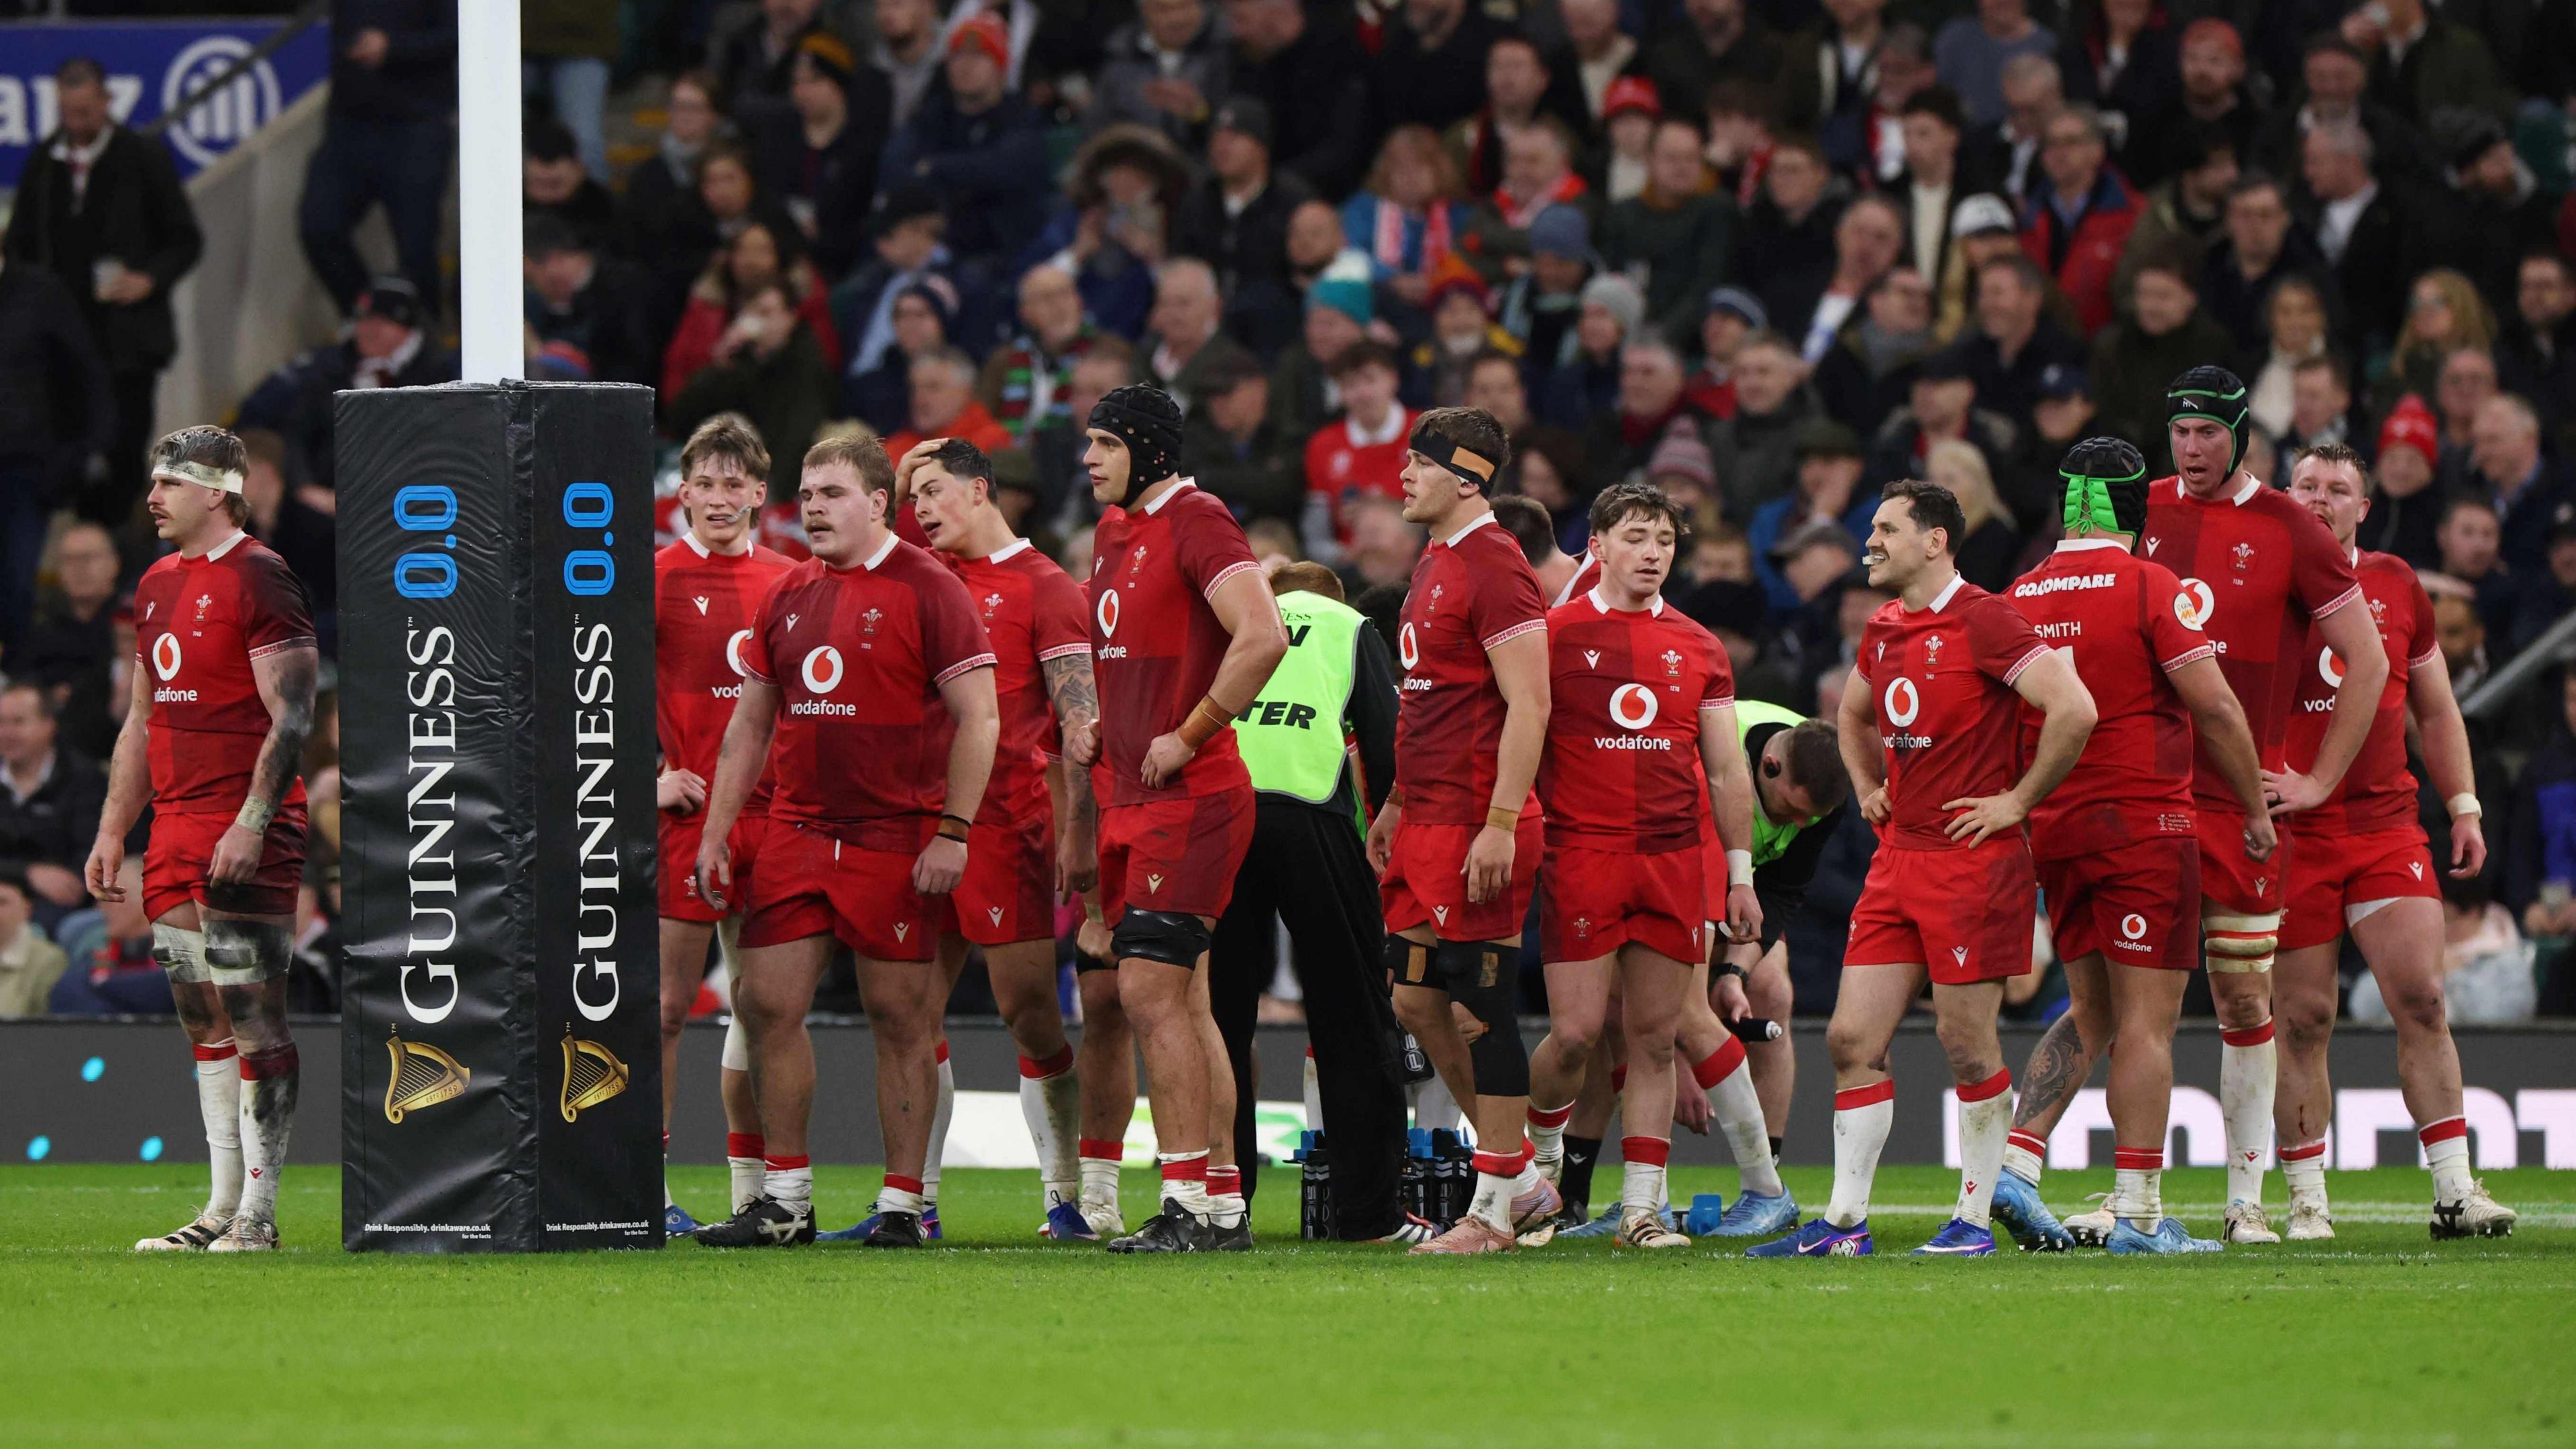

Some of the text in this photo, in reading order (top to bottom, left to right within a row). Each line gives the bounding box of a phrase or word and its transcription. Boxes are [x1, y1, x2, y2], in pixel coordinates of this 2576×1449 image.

[393, 485, 458, 599] 0.0
[563, 482, 615, 596] 0.0
[2015, 573, 2116, 598] GO.COMPARE
[2034, 621, 2081, 639] SMITH
[791, 699, 857, 716] vodafone
[1237, 700, 1317, 730] TER
[1594, 734, 1671, 751] vodafone
[400, 626, 459, 1024] GUINNESS
[572, 623, 620, 1022] GUINNESS
[2113, 938, 2152, 953] vodafone
[364, 1224, 382, 1232] Drink
[430, 1224, 491, 1232] drinkaware.co.uk
[546, 1223, 561, 1232] Drink
[599, 1220, 649, 1230] drinkaware.co.uk
